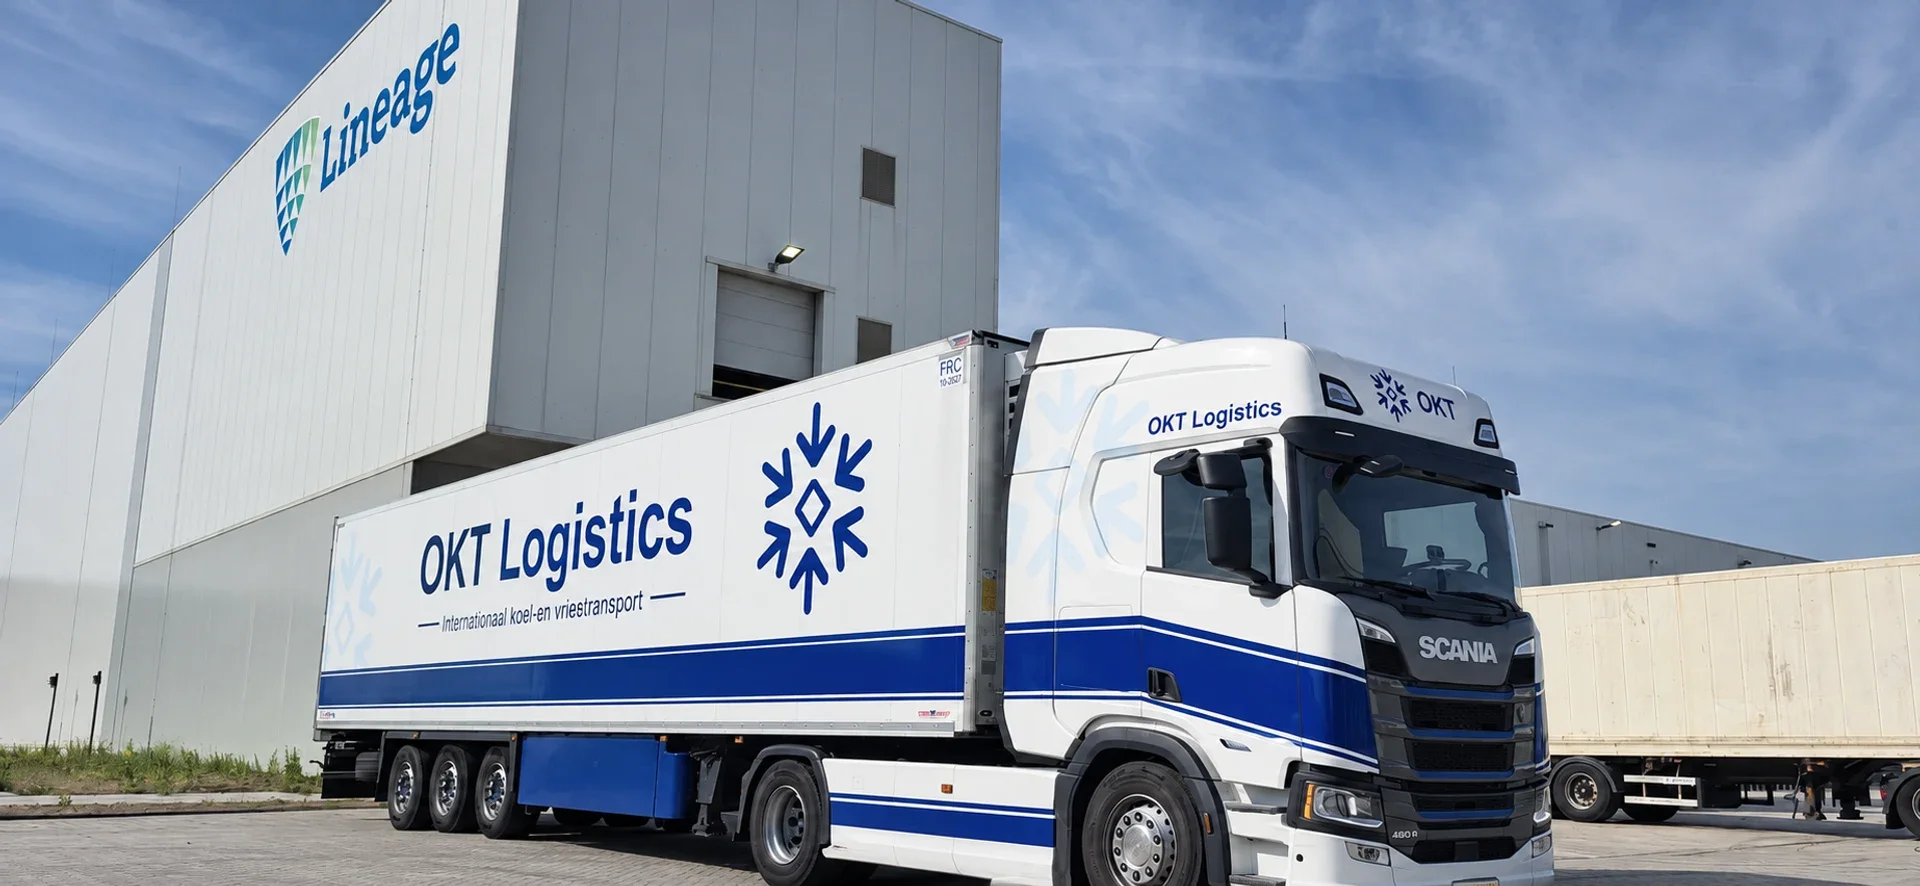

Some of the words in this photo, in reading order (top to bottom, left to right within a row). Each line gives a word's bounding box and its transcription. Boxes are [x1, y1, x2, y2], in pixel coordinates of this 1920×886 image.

[320, 23, 460, 193] Lineage
[940, 357, 962, 376] FRC
[1148, 412, 1187, 435] OKT
[1193, 400, 1282, 430] Logistics
[1417, 390, 1455, 421] OKT
[420, 523, 491, 595] OKT
[500, 488, 692, 592] Logistics
[441, 608, 507, 632] Internationaal
[510, 604, 551, 625] koel-en
[555, 590, 643, 618] vriestransport
[1418, 636, 1498, 664] SCANIA
